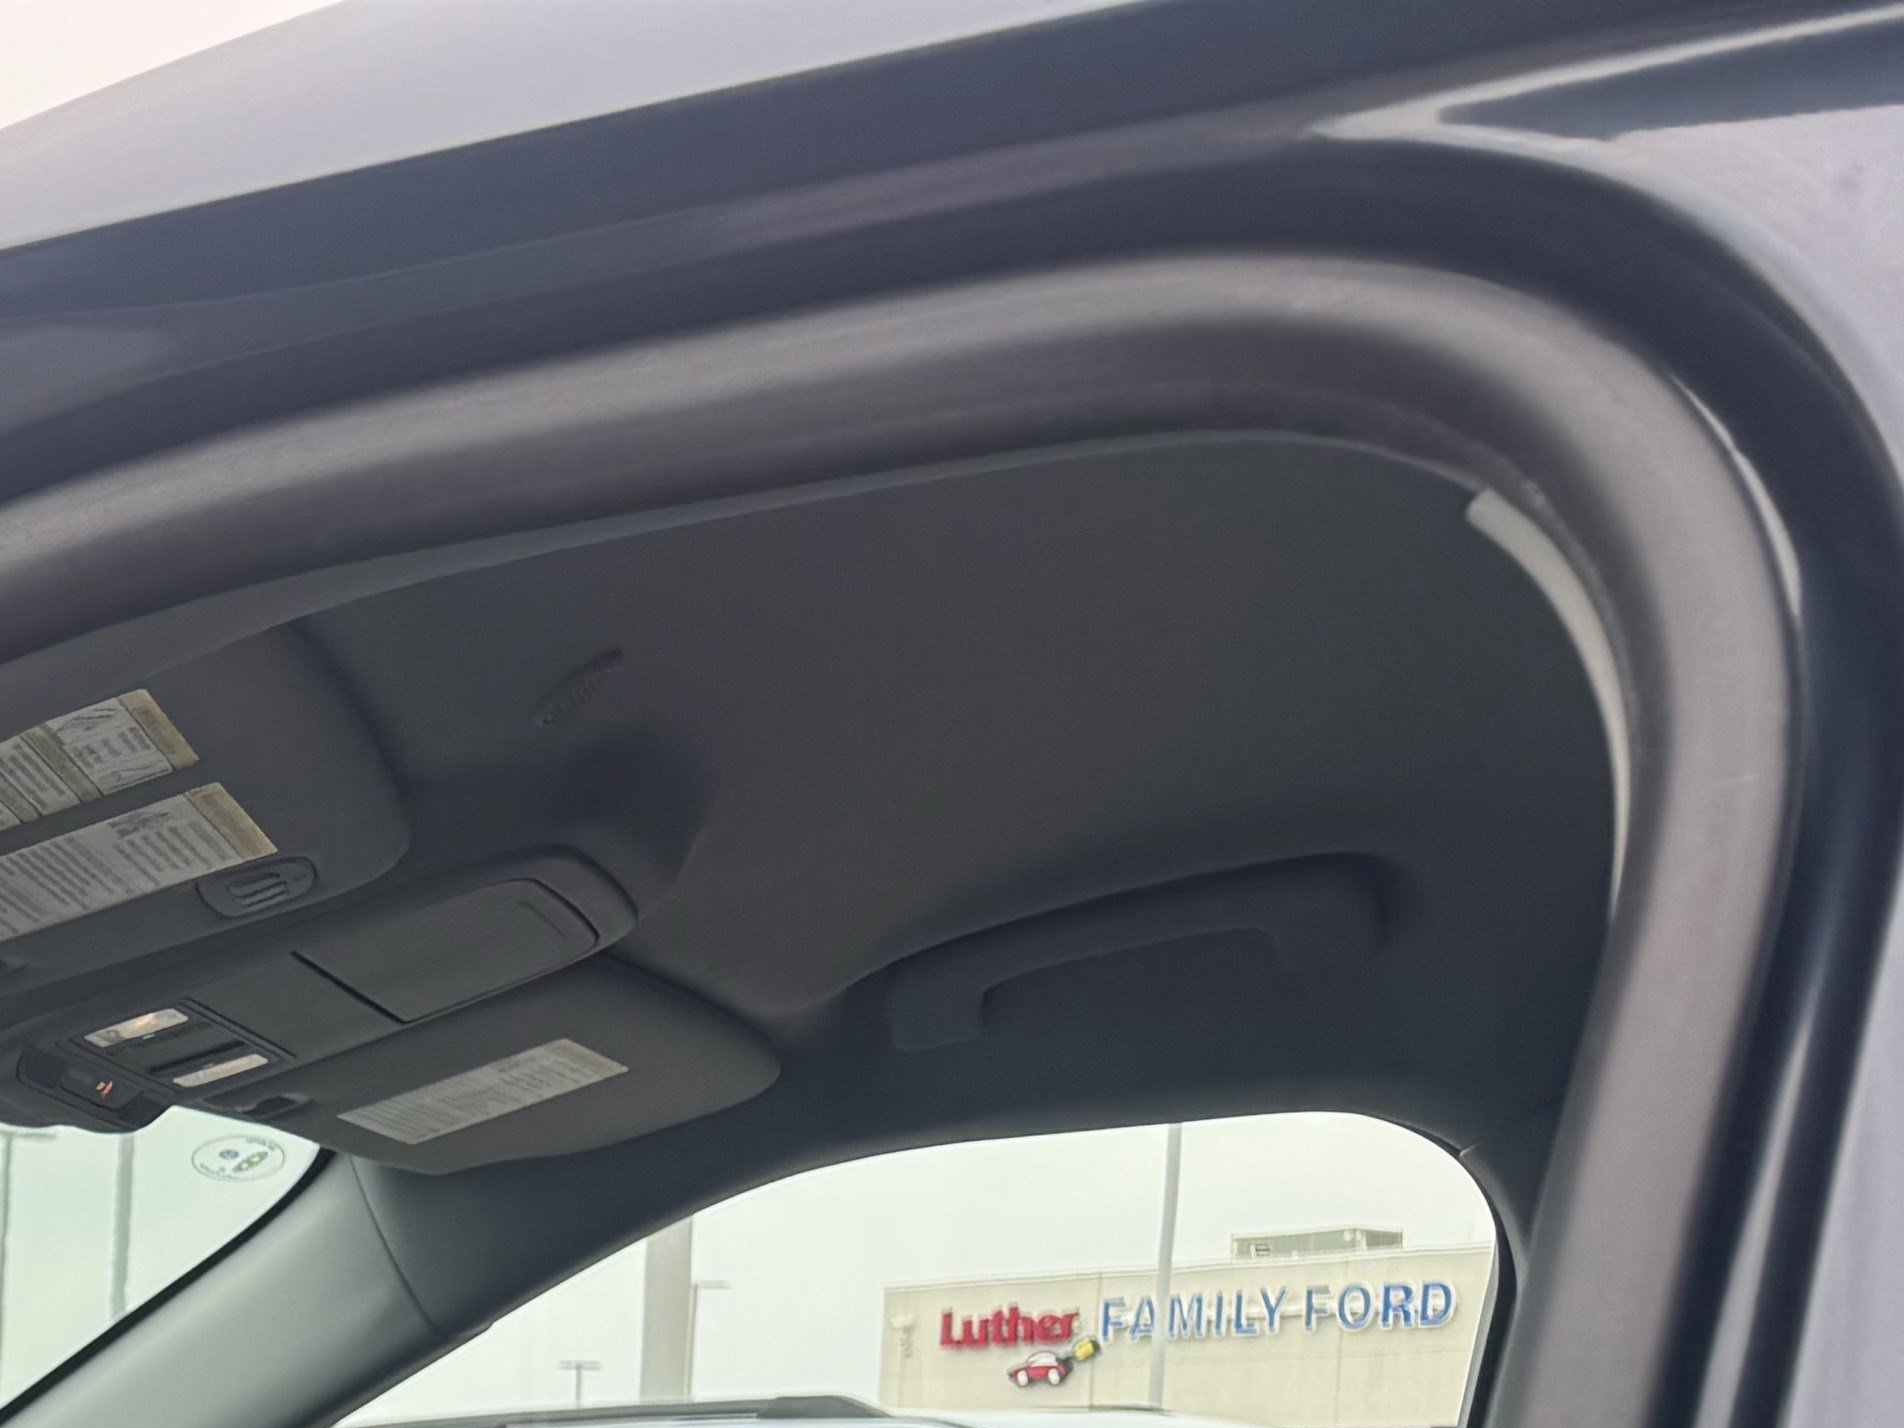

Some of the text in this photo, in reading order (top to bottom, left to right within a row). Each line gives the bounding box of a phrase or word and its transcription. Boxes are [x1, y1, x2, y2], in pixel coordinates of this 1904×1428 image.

[938, 1279, 1456, 1351] Luther FAMILY FORD
